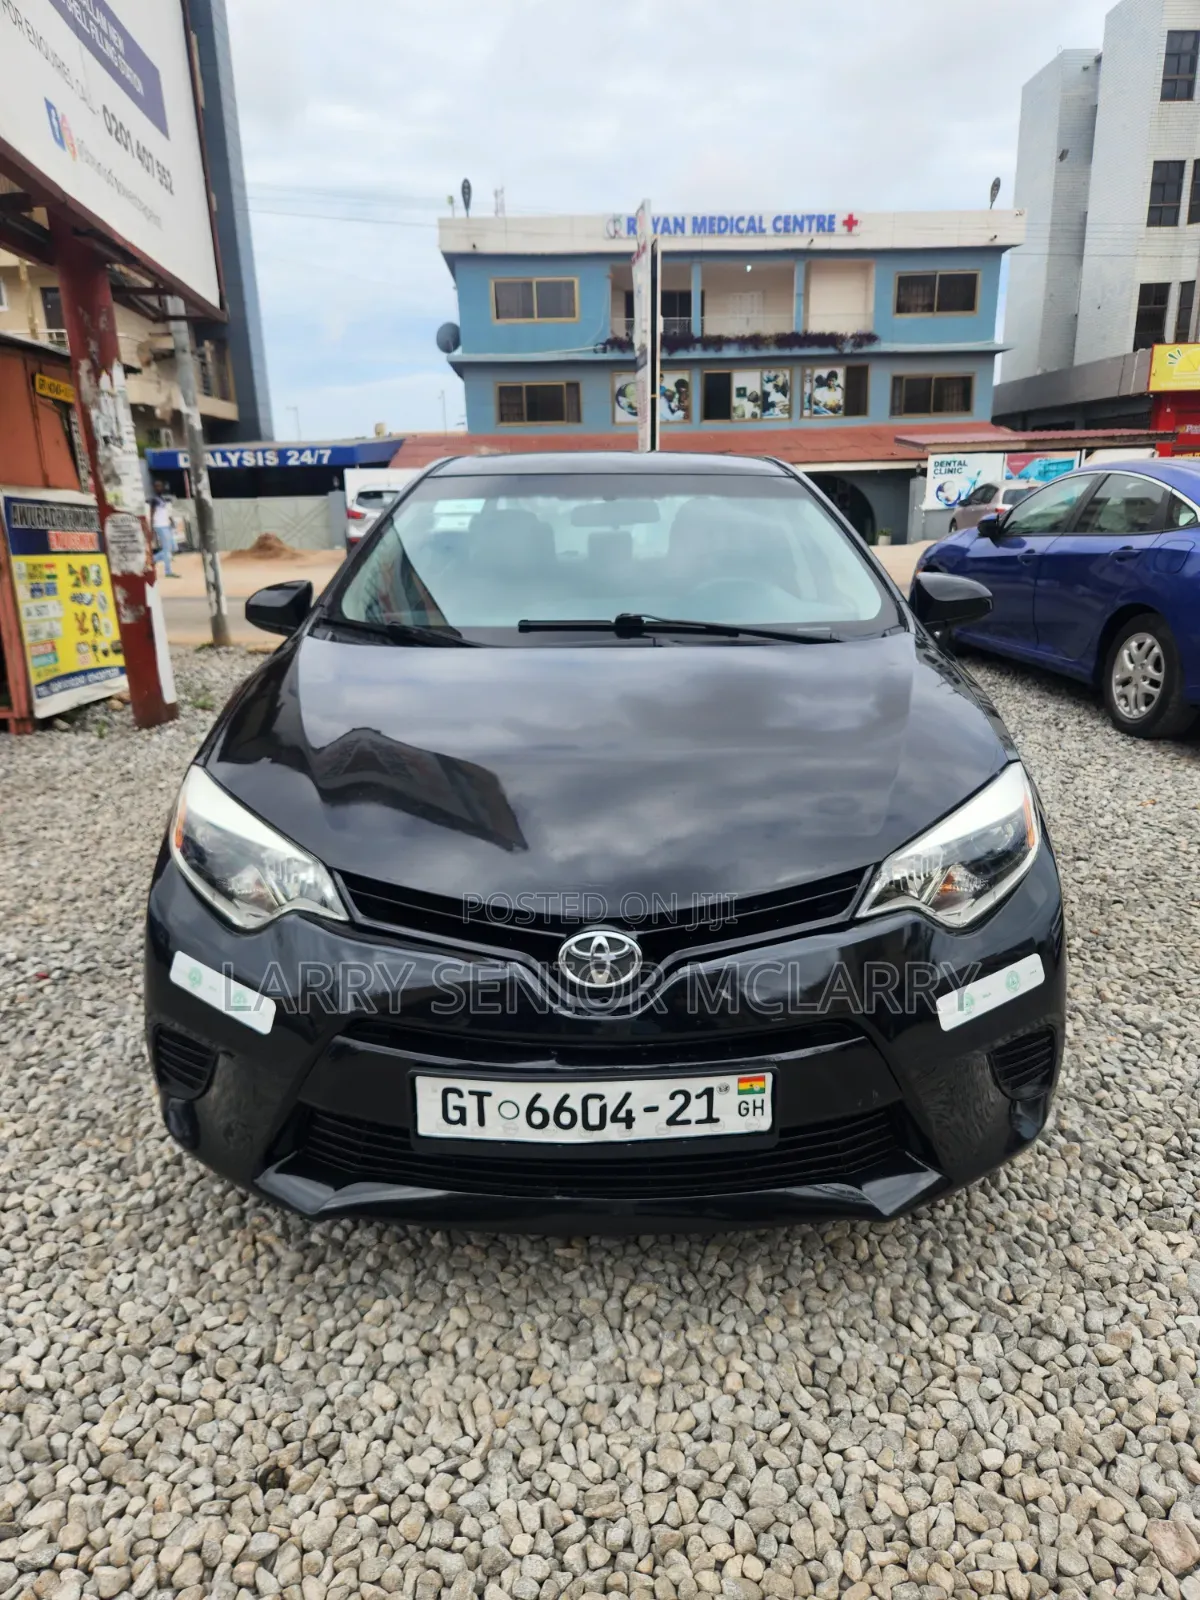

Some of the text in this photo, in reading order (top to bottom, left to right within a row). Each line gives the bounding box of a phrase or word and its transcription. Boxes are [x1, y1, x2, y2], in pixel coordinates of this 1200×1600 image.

[102, 103, 135, 158] 0201
[627, 213, 836, 236] RYAN MEDICAL CENTRE
[177, 449, 332, 468] DALYSIS 24/7
[934, 459, 968, 468] DENTAL
[933, 467, 963, 475] CLINIC
[441, 1086, 493, 1127] GT
[738, 1098, 765, 1117] GH
